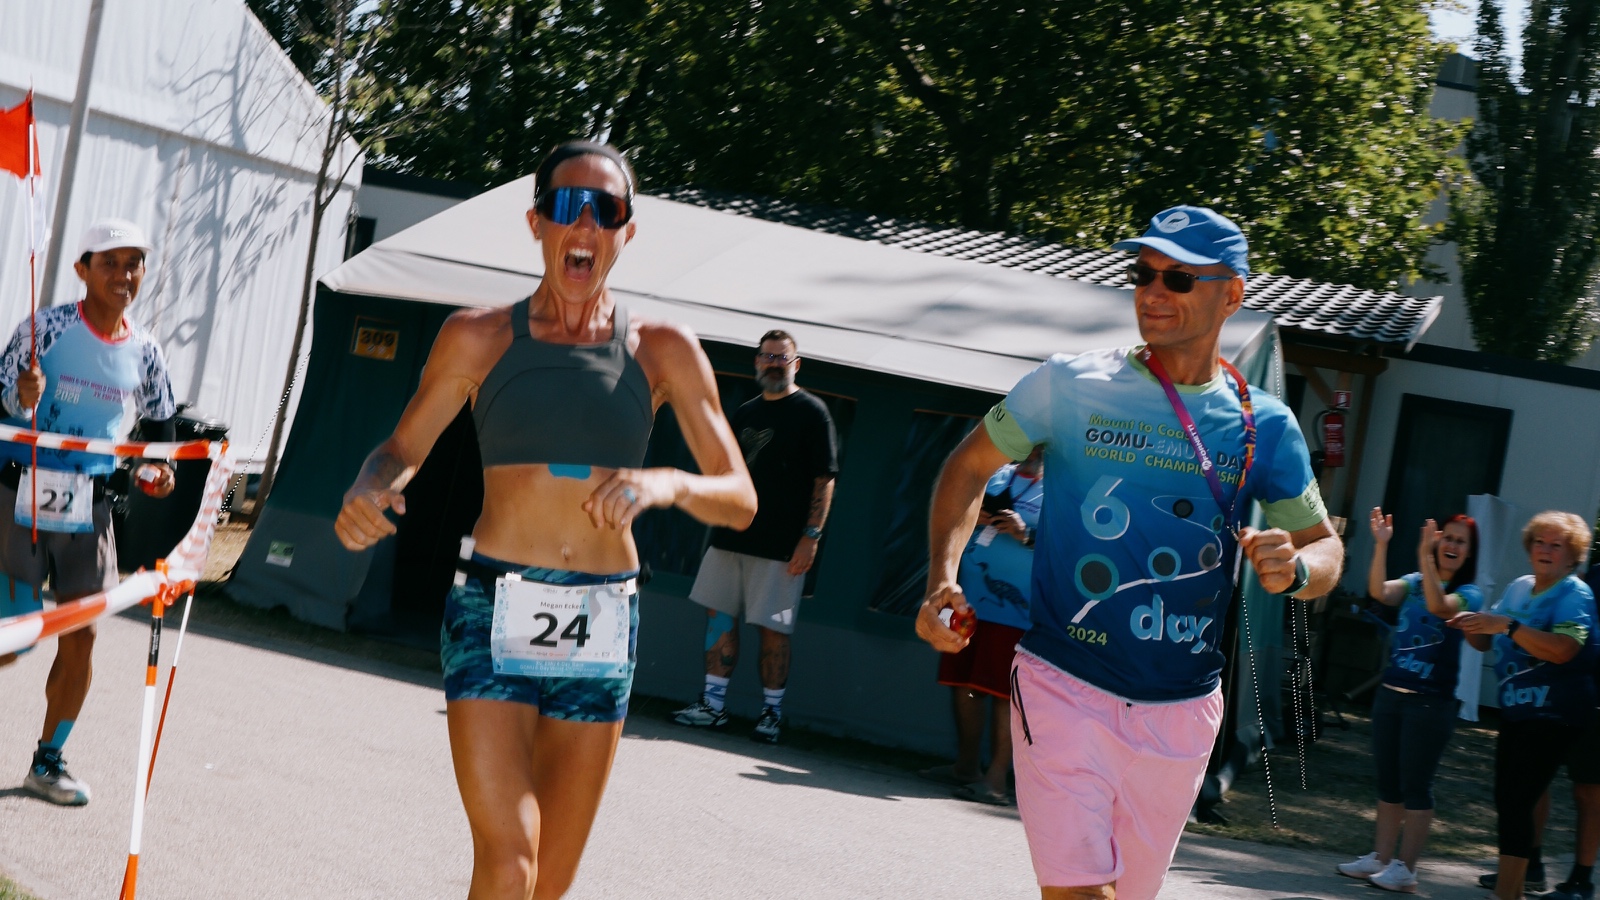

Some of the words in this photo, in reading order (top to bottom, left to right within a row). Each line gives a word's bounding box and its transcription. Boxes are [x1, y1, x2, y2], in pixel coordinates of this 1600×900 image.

[1088, 413, 1135, 430] Mount
[1138, 421, 1153, 433] to
[1085, 446, 1136, 463] WORLD
[1187, 424, 1209, 461] FORNETTI
[39, 488, 74, 513] 22
[1080, 475, 1131, 540] 6
[540, 601, 563, 610] Megan
[564, 602, 586, 610] Eckert
[529, 611, 591, 648] 24
[1066, 625, 1108, 646] 2024
[1130, 594, 1213, 654] day
[1502, 683, 1551, 708] day
